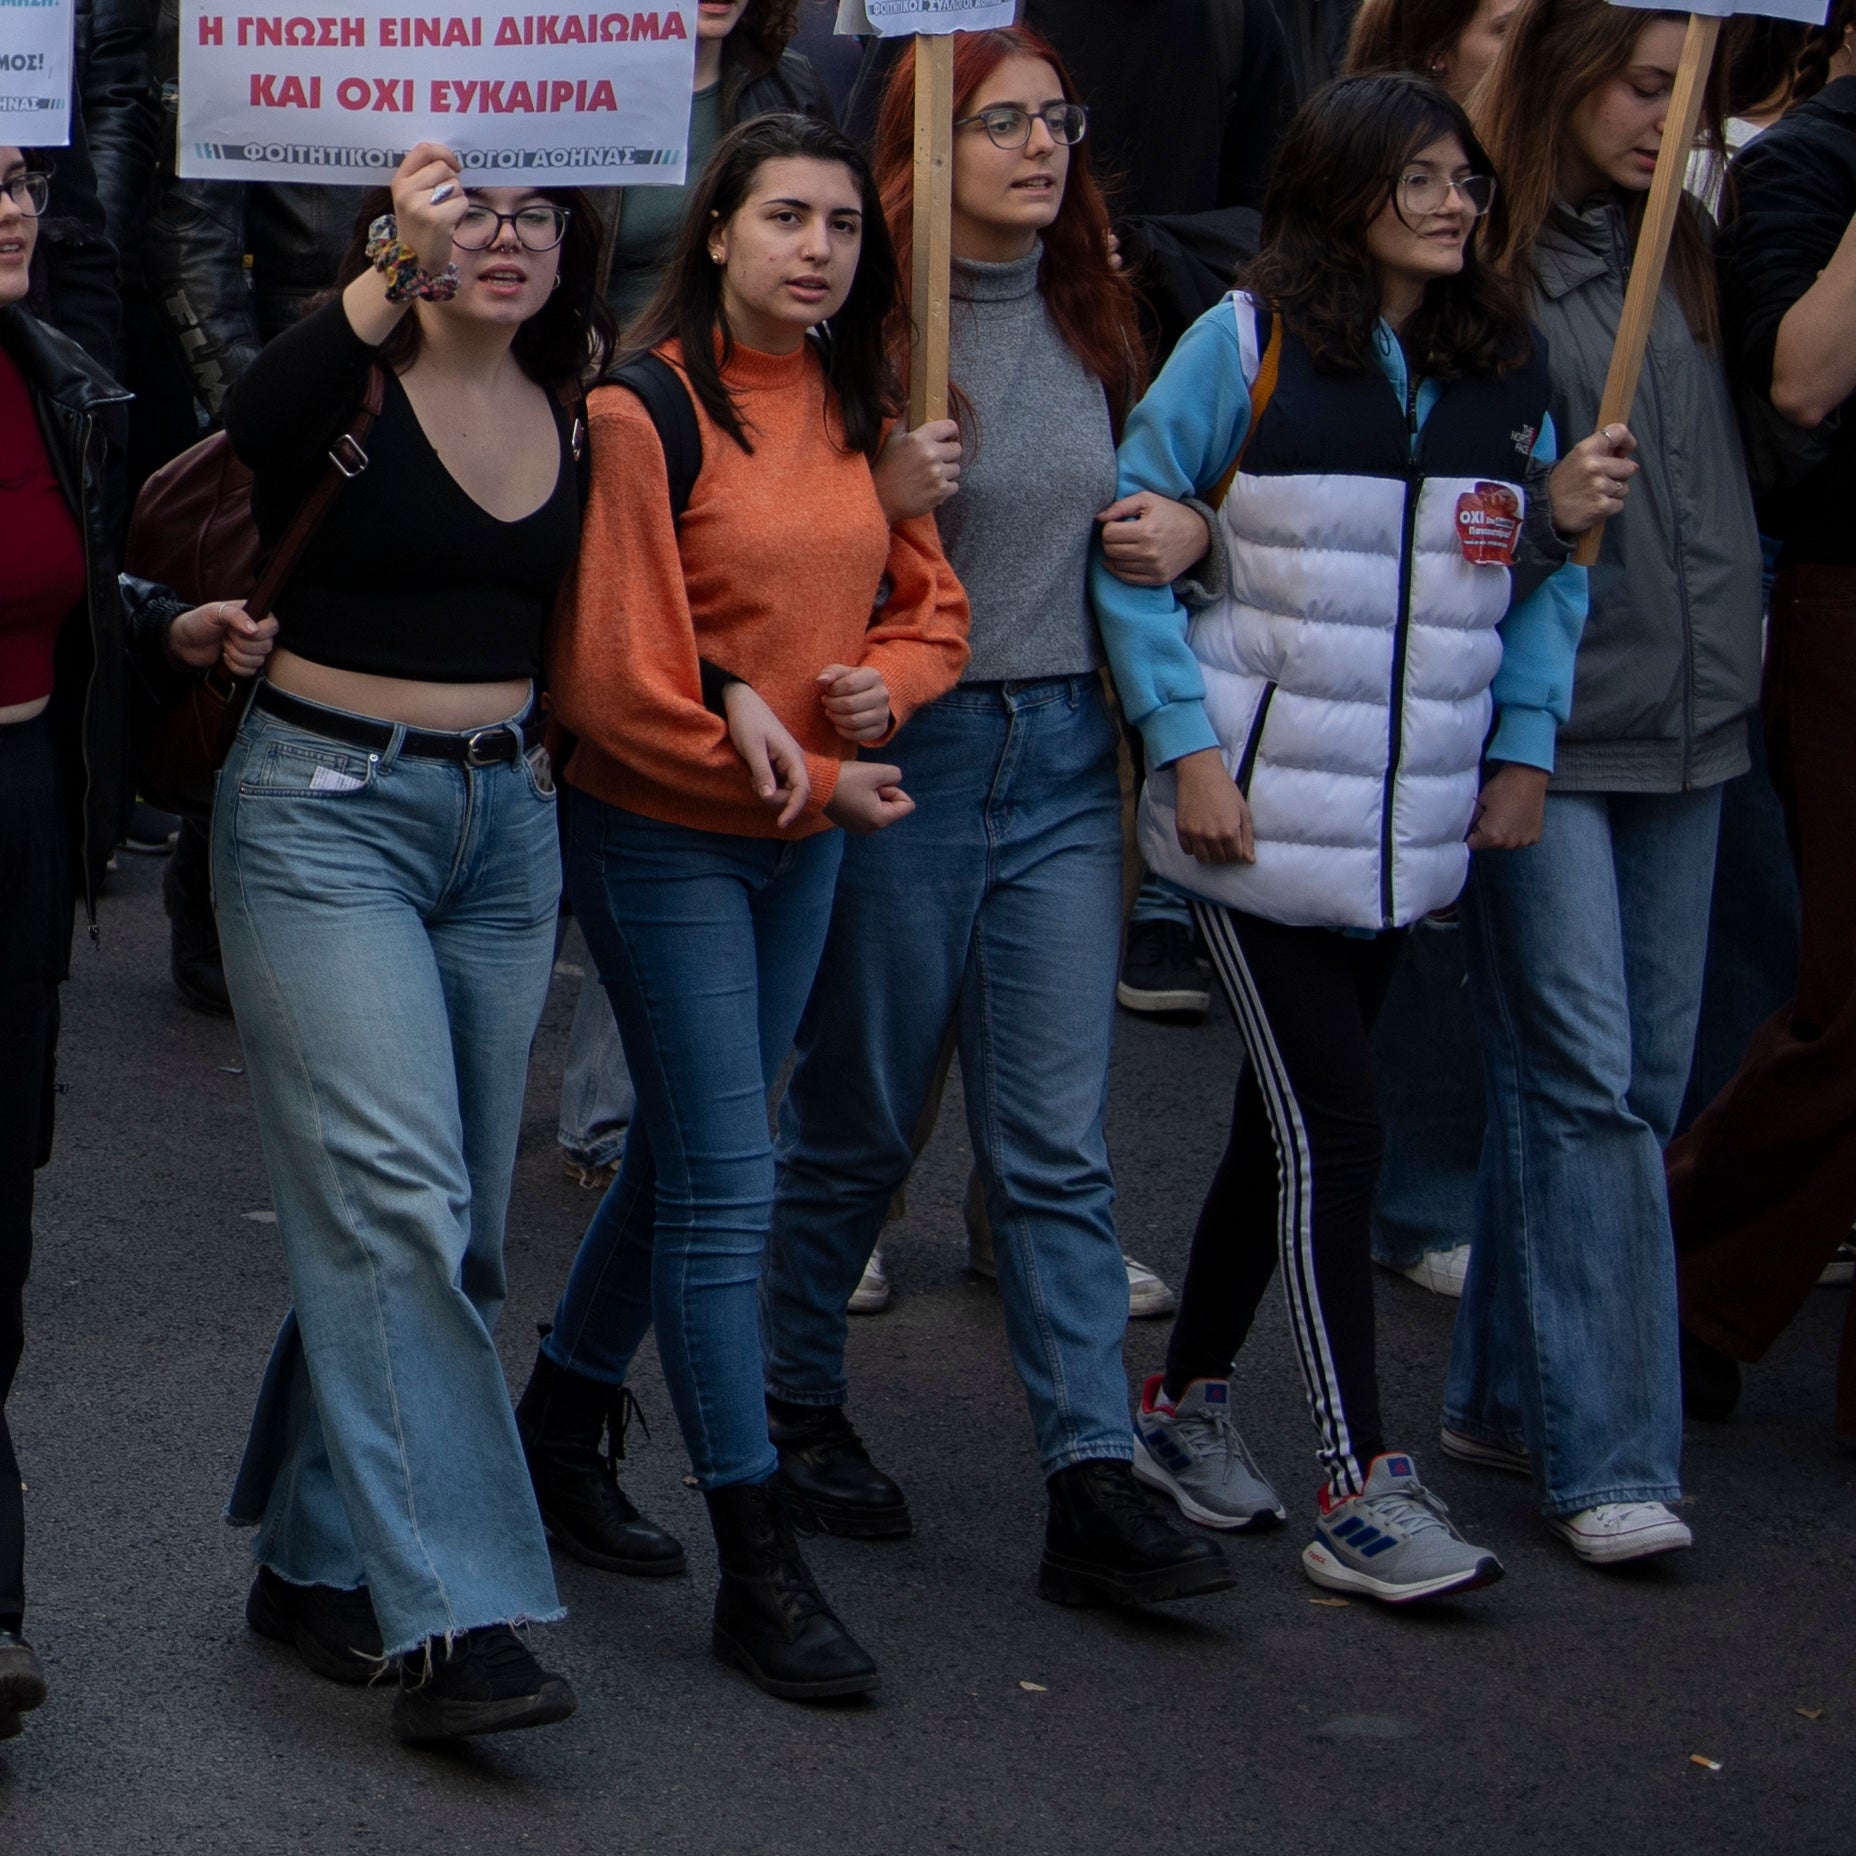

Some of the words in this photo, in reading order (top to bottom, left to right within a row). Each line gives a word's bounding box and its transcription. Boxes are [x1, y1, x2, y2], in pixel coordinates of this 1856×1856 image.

[198, 15, 223, 47] Η
[237, 15, 366, 48] ΓΝΩΣΗ
[380, 15, 483, 47] ΕΙΝΑΙ
[494, 10, 688, 48] ΔΙΚΑΙΩΜΑ
[250, 73, 322, 110] ΚΑΙ
[336, 76, 414, 113] ΟΧΙ
[430, 79, 617, 115] ΕΥΚΑΙΡΙΑ
[243, 142, 396, 168] ΦΟΙΤΗΤΙΚΟΙ
[532, 147, 636, 170] ΑΘΗΝΑΣ
